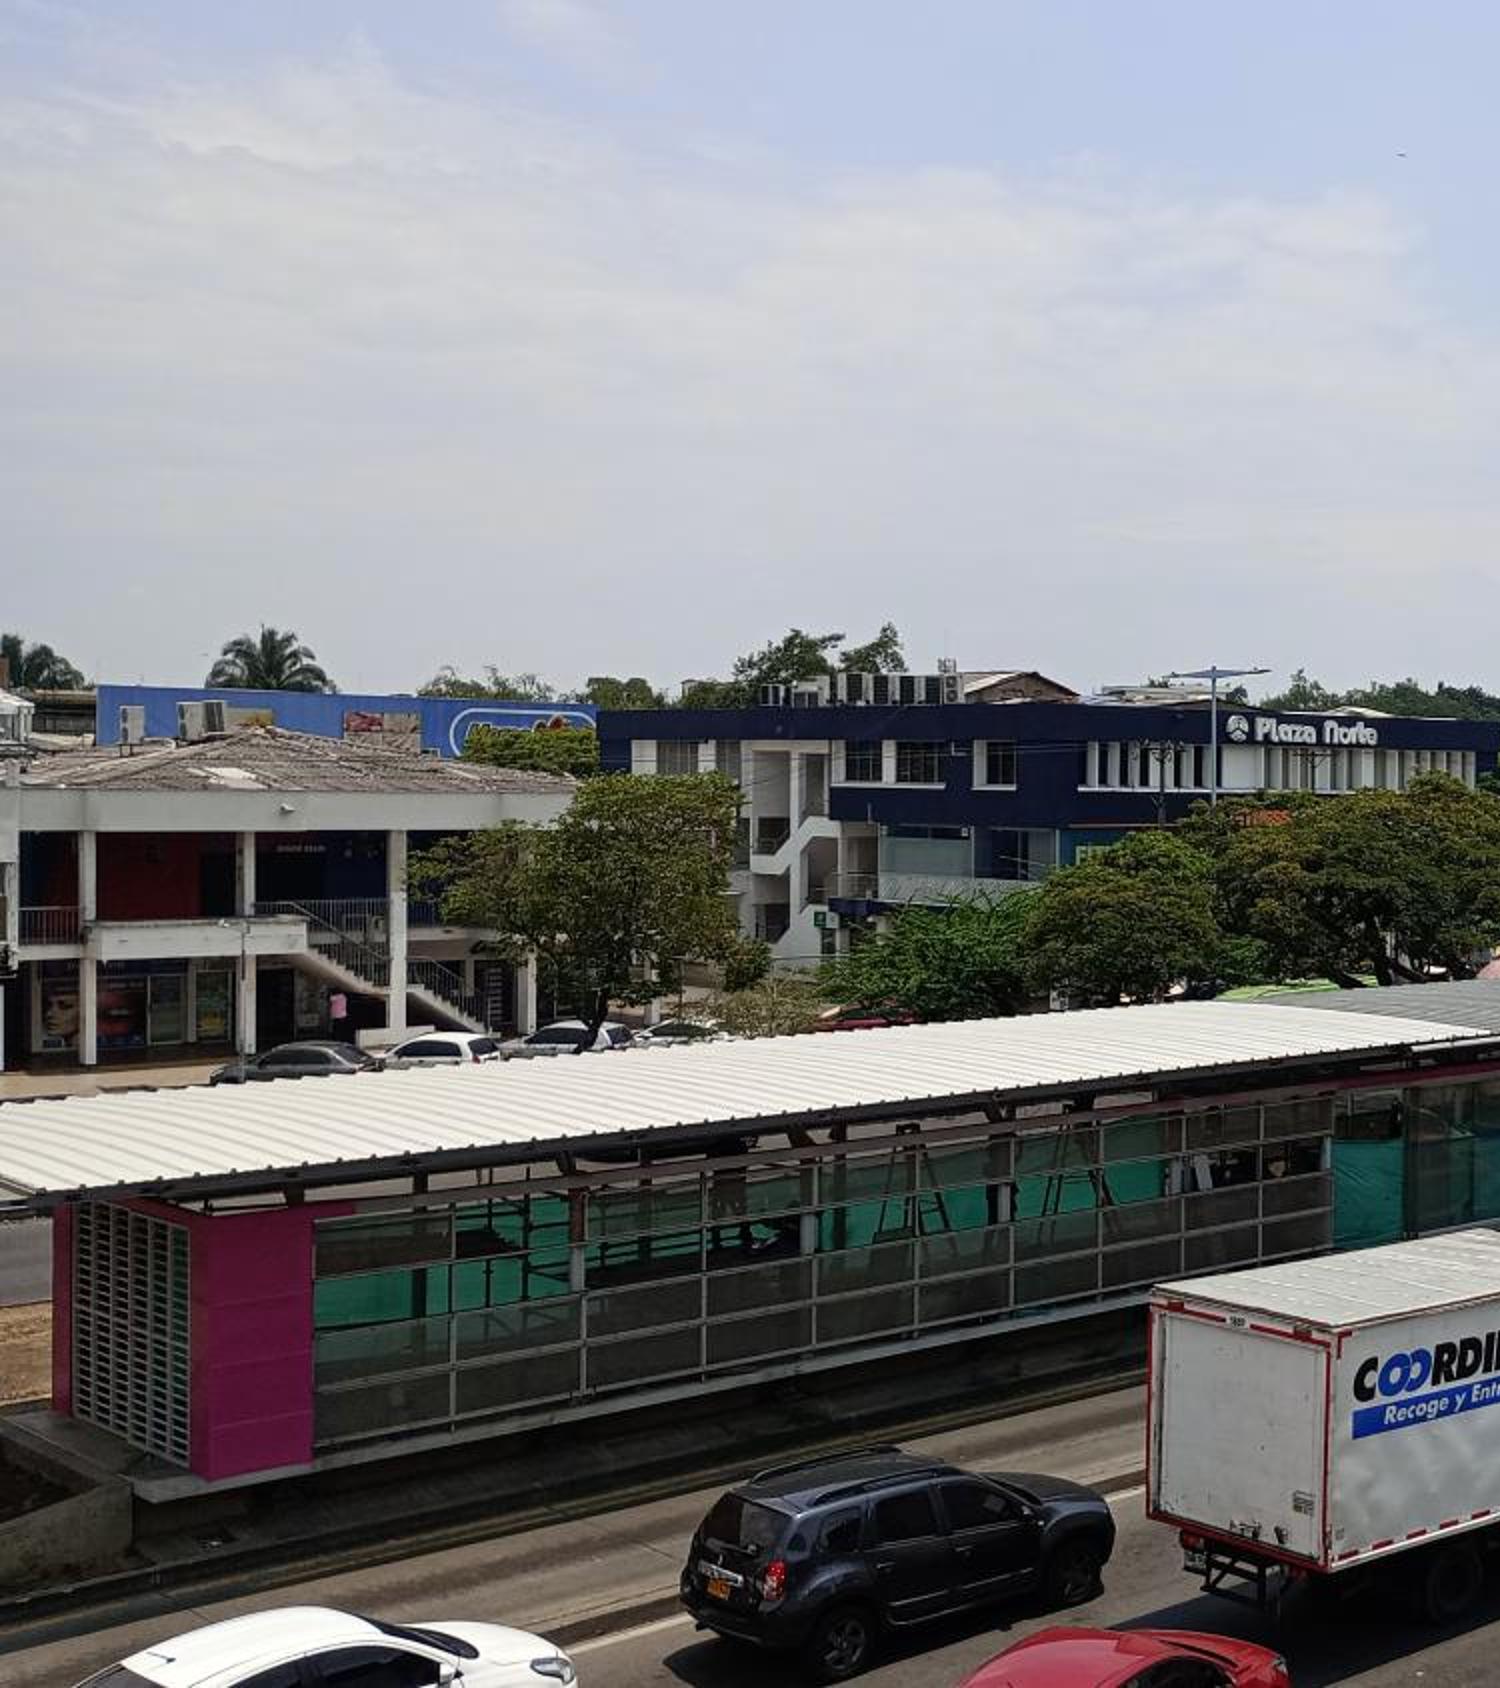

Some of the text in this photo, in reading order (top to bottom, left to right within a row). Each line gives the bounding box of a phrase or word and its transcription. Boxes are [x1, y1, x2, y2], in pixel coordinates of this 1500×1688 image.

[1254, 717, 1379, 746] Plaza Norte
[1384, 1400, 1449, 1426] Recoge
[1453, 1391, 1467, 1413] y
